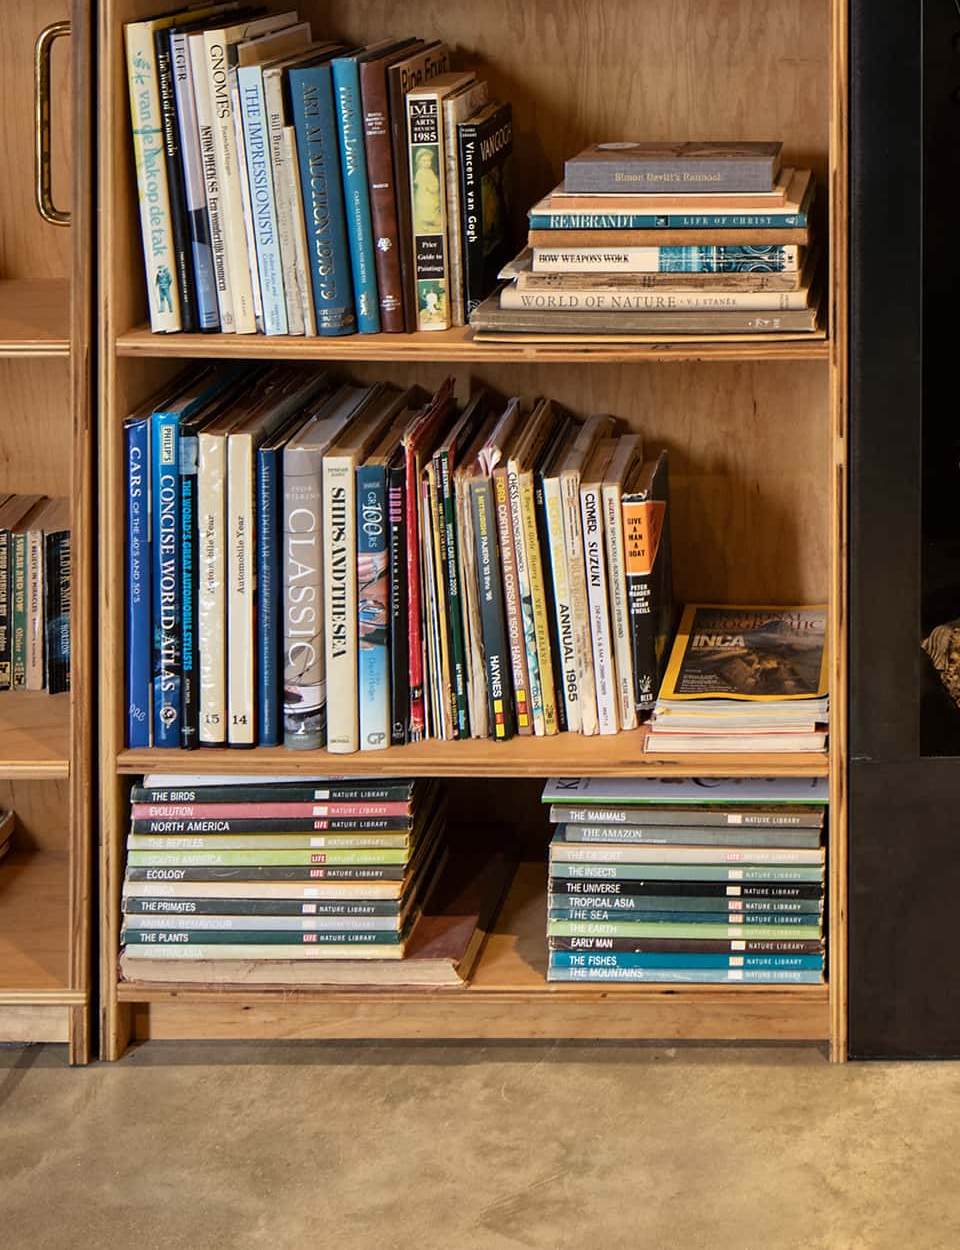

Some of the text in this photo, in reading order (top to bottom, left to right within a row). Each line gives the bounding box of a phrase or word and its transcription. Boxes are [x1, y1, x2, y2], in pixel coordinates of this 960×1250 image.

[209, 44, 231, 120] GNOMES
[159, 52, 179, 157] The World of Leonardo
[244, 84, 262, 117] THE
[415, 118, 435, 126] ARTS
[270, 113, 286, 167] Bill Brandt
[412, 131, 437, 143] 1985
[464, 141, 475, 186] Vincent
[139, 91, 168, 257] van de tak
[248, 122, 275, 246] IMPRESSIONISTS
[302, 83, 338, 301] ART AT AUCTION 1978-79
[467, 190, 476, 212] van
[467, 214, 478, 244] Gogh
[550, 213, 774, 229] REMBRANDT LIFE OF CHRIST
[421, 241, 438, 249] Price
[416, 253, 435, 261] Guide
[539, 253, 631, 263] HOW WEAPONS WORK
[416, 265, 444, 275] Paintings
[521, 295, 678, 308] WORLD OF NATURE
[163, 427, 173, 463] PHILIP'S
[129, 446, 142, 499] CARS
[507, 471, 520, 502] CHESS
[132, 501, 141, 516] OF
[389, 487, 402, 523] TURBO
[331, 487, 347, 543] SHIPS
[361, 501, 383, 537] 100
[584, 493, 599, 535] CLYMER
[627, 517, 643, 527] GIVE
[132, 518, 141, 534] THE
[205, 514, 216, 540] Year
[628, 534, 644, 542] MAN
[236, 515, 246, 594] Automobile Year
[479, 536, 492, 564] PAJERO
[628, 549, 646, 559] BOAT
[133, 558, 142, 580] AND
[331, 543, 347, 582] AND
[588, 541, 602, 588] SUZUKI
[182, 479, 194, 671] THE WORLD'S GREAT AUTOMOBILE STYLISTS
[496, 477, 525, 687] FORD CORTINA CORSAIR HAYNES
[160, 474, 177, 693] CONCISE WORLD ATLAS
[288, 507, 317, 668] CLASSIC
[449, 578, 458, 596] 2000
[630, 583, 648, 592] PETER
[331, 582, 347, 623] THE
[331, 622, 347, 659] SEA
[559, 603, 575, 664] ANNUAL
[692, 634, 746, 648] INCA
[489, 655, 503, 699] HAYNES
[566, 669, 579, 703] 1965
[205, 709, 219, 726] 15
[232, 713, 248, 726] 14
[152, 791, 196, 802] THE BIRDS
[149, 806, 194, 817] EVOLUTION
[569, 810, 628, 822] THE MAMMALS
[150, 820, 231, 831] NORTH AMERICA
[314, 821, 328, 829] LIFE
[582, 829, 643, 840] THE AMAZON
[311, 854, 326, 863] LIFE
[146, 869, 186, 879] ECOLOGY
[310, 869, 324, 877] LIFE
[567, 866, 617, 877] THE INSECTS
[566, 882, 622, 894] THE UNIVERSE
[141, 901, 196, 912] THE PRIMATES
[568, 897, 635, 909] TROPICAL ASIA
[569, 909, 610, 921] THE SEA
[141, 933, 189, 943] THE PLANTS
[303, 933, 318, 942] LIFE
[570, 937, 614, 949] EARLY MAN
[569, 955, 618, 967] THE FISHES
[568, 967, 643, 979] THE MOUNTAINS
